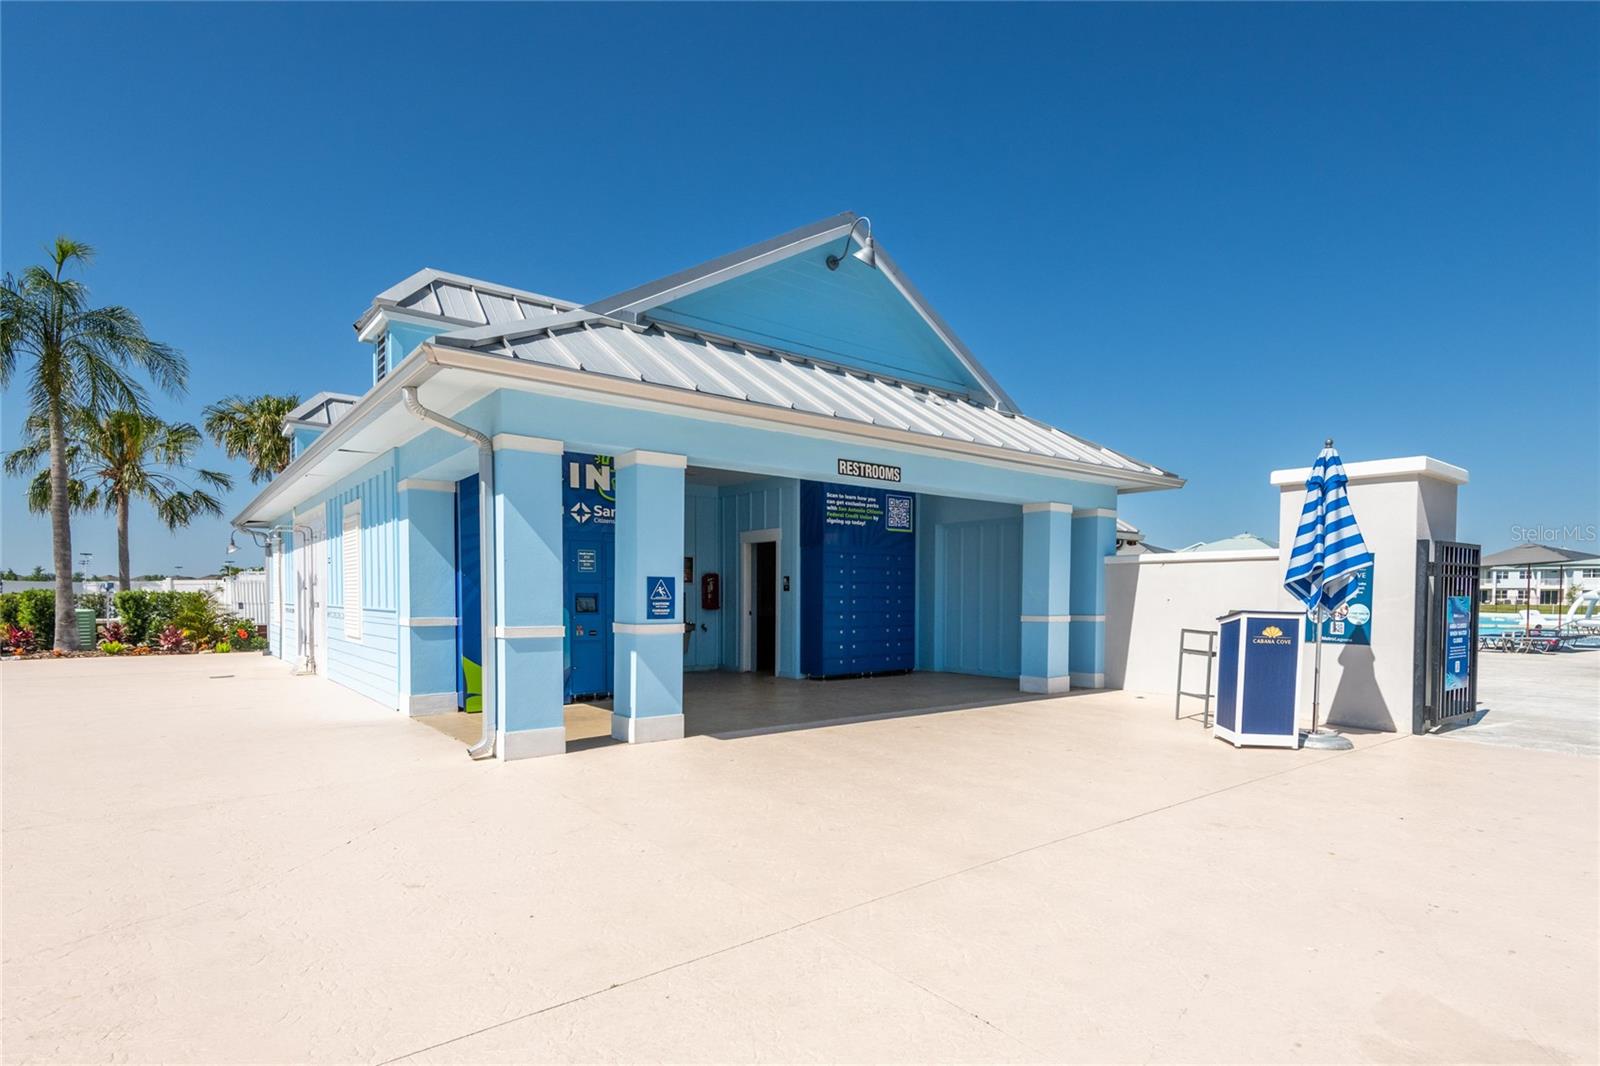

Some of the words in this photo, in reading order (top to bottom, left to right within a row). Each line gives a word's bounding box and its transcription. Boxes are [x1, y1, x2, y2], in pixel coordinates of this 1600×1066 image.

[839, 460, 900, 481] RESTROOMS
[826, 517, 844, 525] signing
[851, 519, 866, 527] today!
